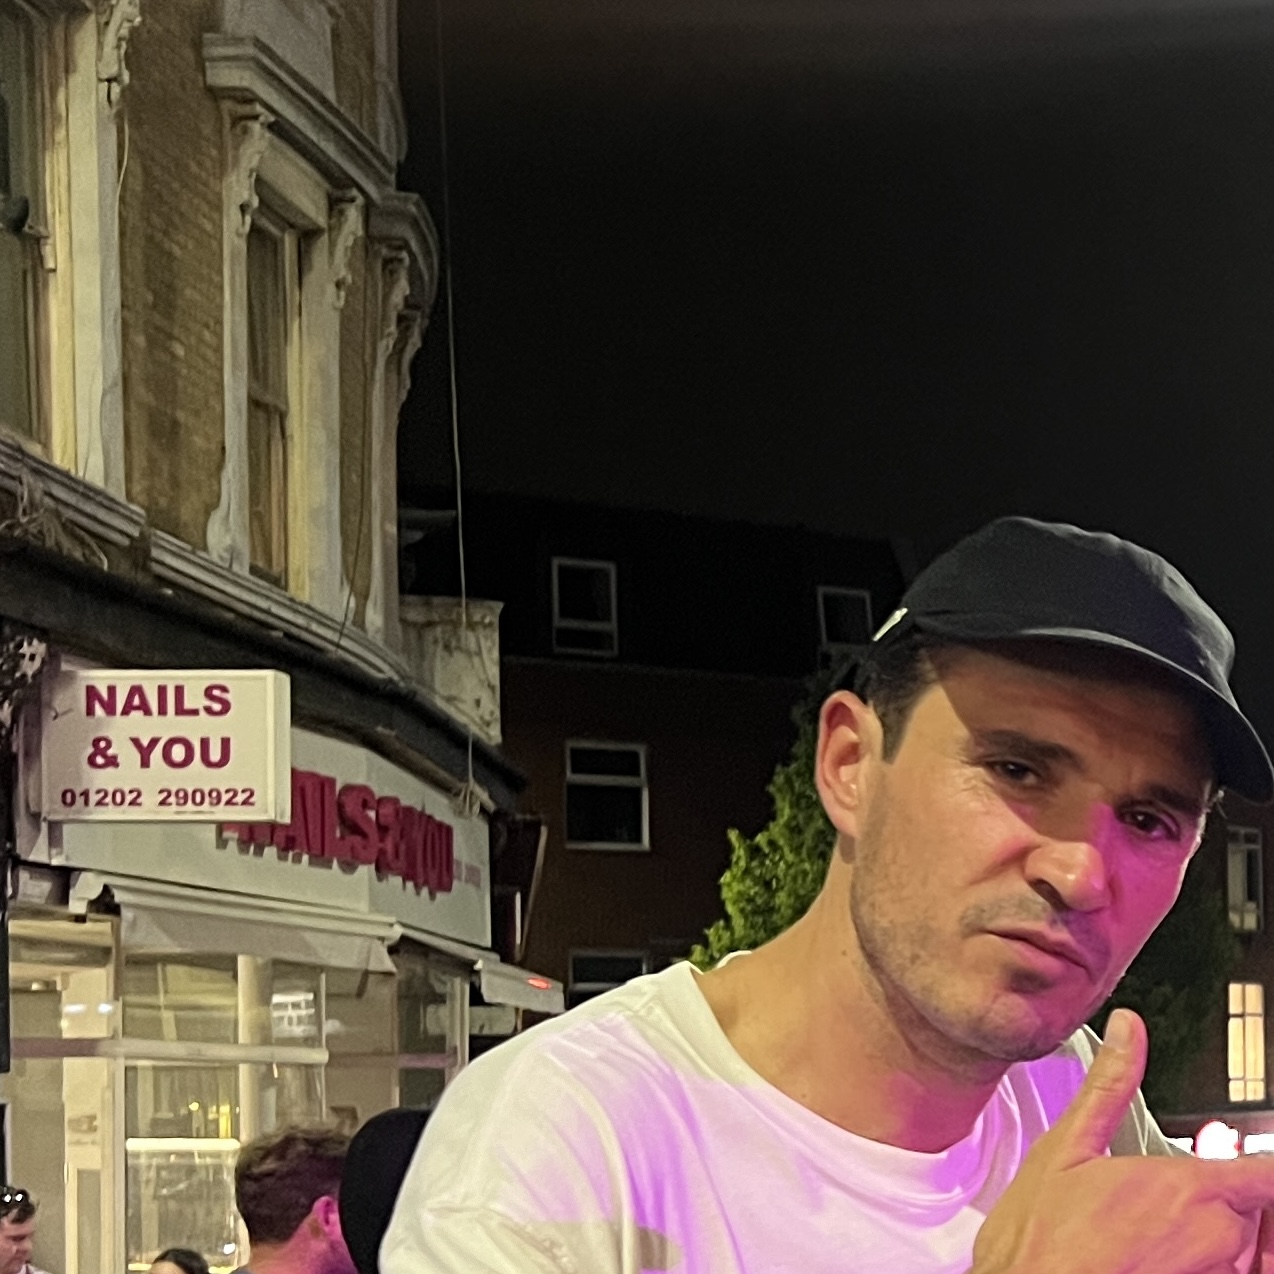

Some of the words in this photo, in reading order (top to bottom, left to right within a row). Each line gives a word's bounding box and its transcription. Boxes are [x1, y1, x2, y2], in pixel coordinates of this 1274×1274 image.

[85, 683, 232, 718] NAILS
[86, 735, 120, 769] &
[129, 736, 231, 769] YOU
[61, 788, 143, 807] 01202
[157, 788, 256, 807] 290922
